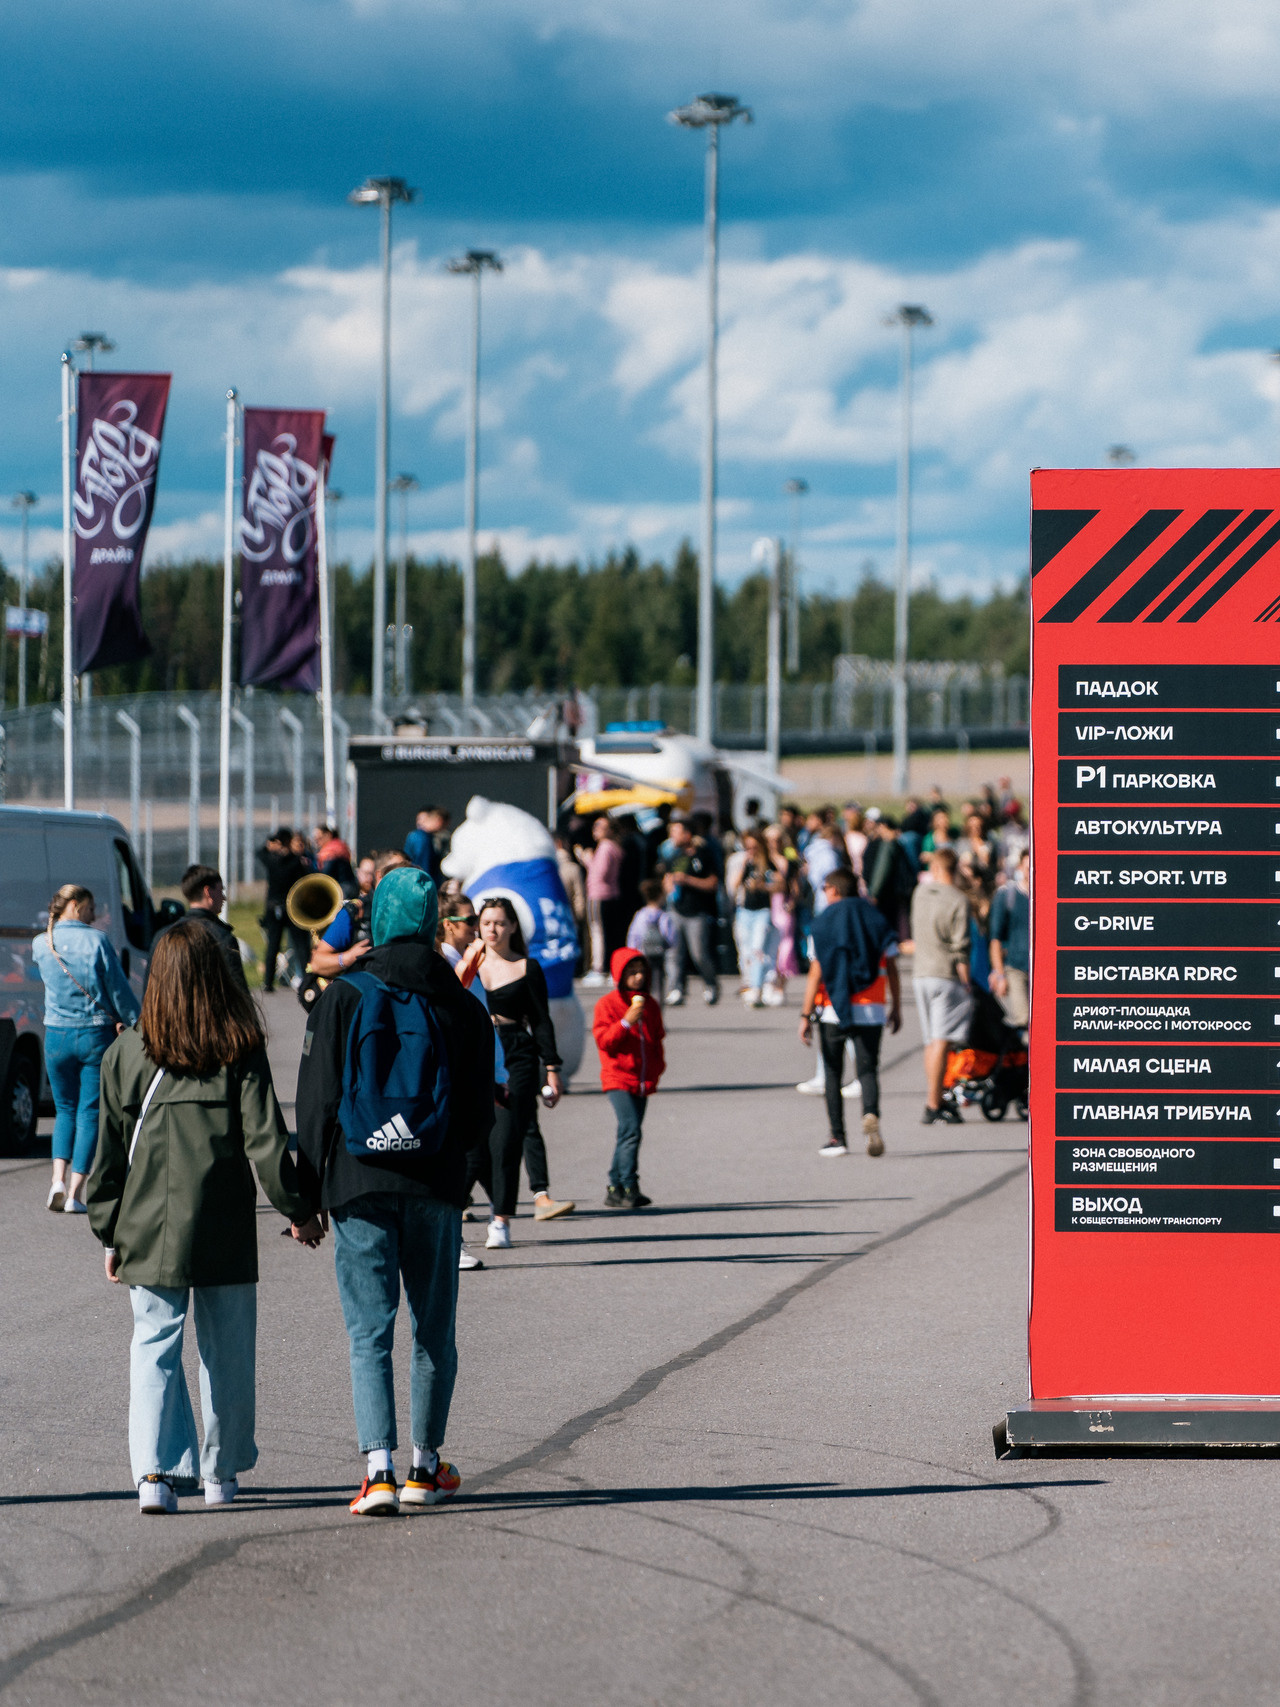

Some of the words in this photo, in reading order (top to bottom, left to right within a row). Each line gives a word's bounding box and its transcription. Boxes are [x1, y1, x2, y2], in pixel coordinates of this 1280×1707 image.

[1075, 680, 1159, 698] ПАДДОК
[1075, 725, 1174, 741] VIP-ЛОЖИ
[1075, 765, 1107, 789] P1
[1112, 773, 1217, 789] ПАРКОВКА
[1074, 819, 1223, 835] АВТОКУЛЬТУРА
[1074, 869, 1114, 885] ART.
[1118, 869, 1186, 885] SPORT.
[1190, 869, 1228, 885] VTB
[1074, 915, 1155, 931] G-DRIVE
[1073, 965, 1180, 981] ВЫСТАВКА
[1184, 966, 1238, 982] RDRC
[1073, 1005, 1191, 1018] ДРИФТ-ПЛОЩАДКА
[1073, 1020, 1162, 1031] РАЛЛИ-КРОСС
[1171, 1020, 1252, 1031] МОТОКРОСС
[1073, 1058, 1140, 1073] МАЛАЯ
[1145, 1058, 1212, 1076] СЦЕНА
[1073, 1105, 1159, 1120] ГЛАВНАЯ
[1164, 1105, 1252, 1121] ТРИБУНА
[366, 1137, 421, 1151] adidas
[1072, 1147, 1106, 1158] ЗОНА
[1108, 1147, 1196, 1159] СВОБОДНОГО
[1072, 1162, 1158, 1174] РАЗМЕЩЕНИЯ
[1072, 1196, 1143, 1215] ВЫХОД
[1071, 1216, 1078, 1225] К
[1079, 1216, 1162, 1226] ОБЩЕСТВЕННОМУ
[1162, 1216, 1222, 1226] ТРАНСПОРТУ
